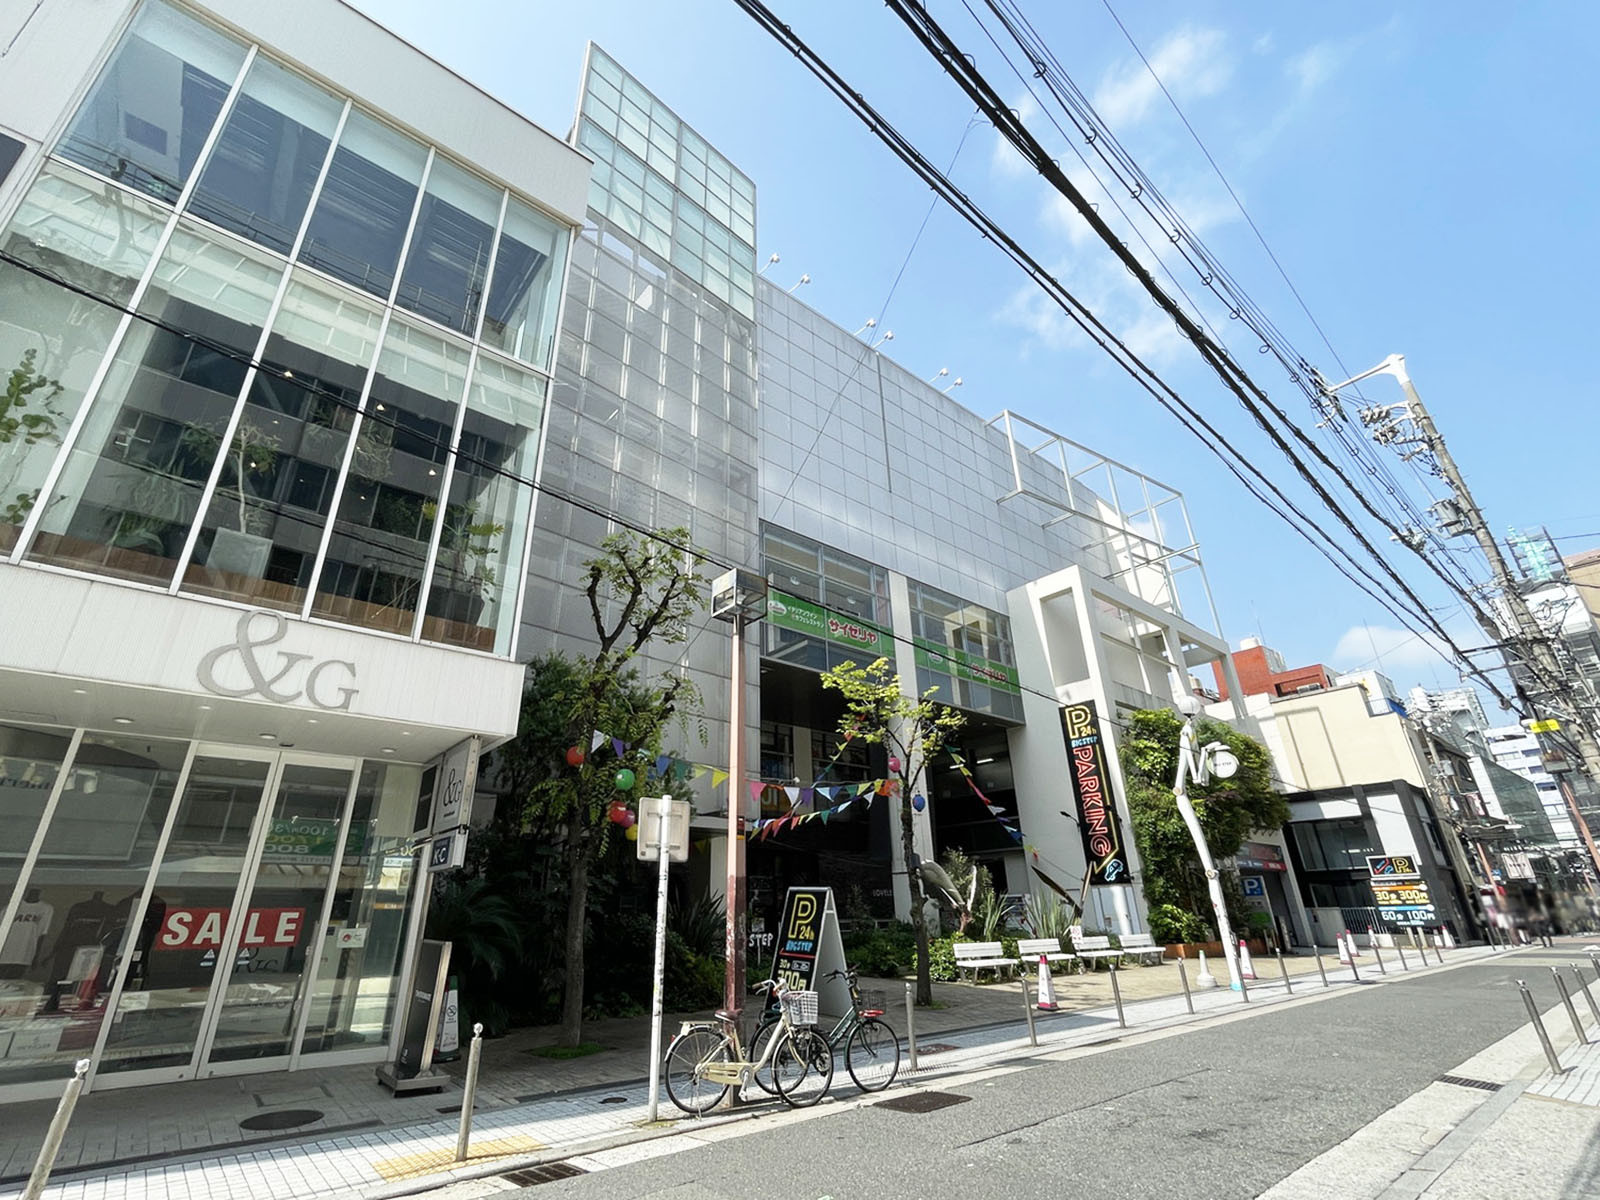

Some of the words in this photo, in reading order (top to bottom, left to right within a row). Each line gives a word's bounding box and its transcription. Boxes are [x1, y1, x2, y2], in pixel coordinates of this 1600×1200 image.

[828, 617, 878, 645] サイゼリヤ
[198, 610, 359, 711] &G
[1065, 705, 1092, 740] P
[1072, 744, 1112, 857] PARKING
[1392, 858, 1408, 873] P
[1243, 878, 1259, 894] P
[162, 911, 300, 947] SALE
[788, 894, 817, 939] P
[748, 932, 774, 947] STEP
[799, 925, 815, 941] 24h
